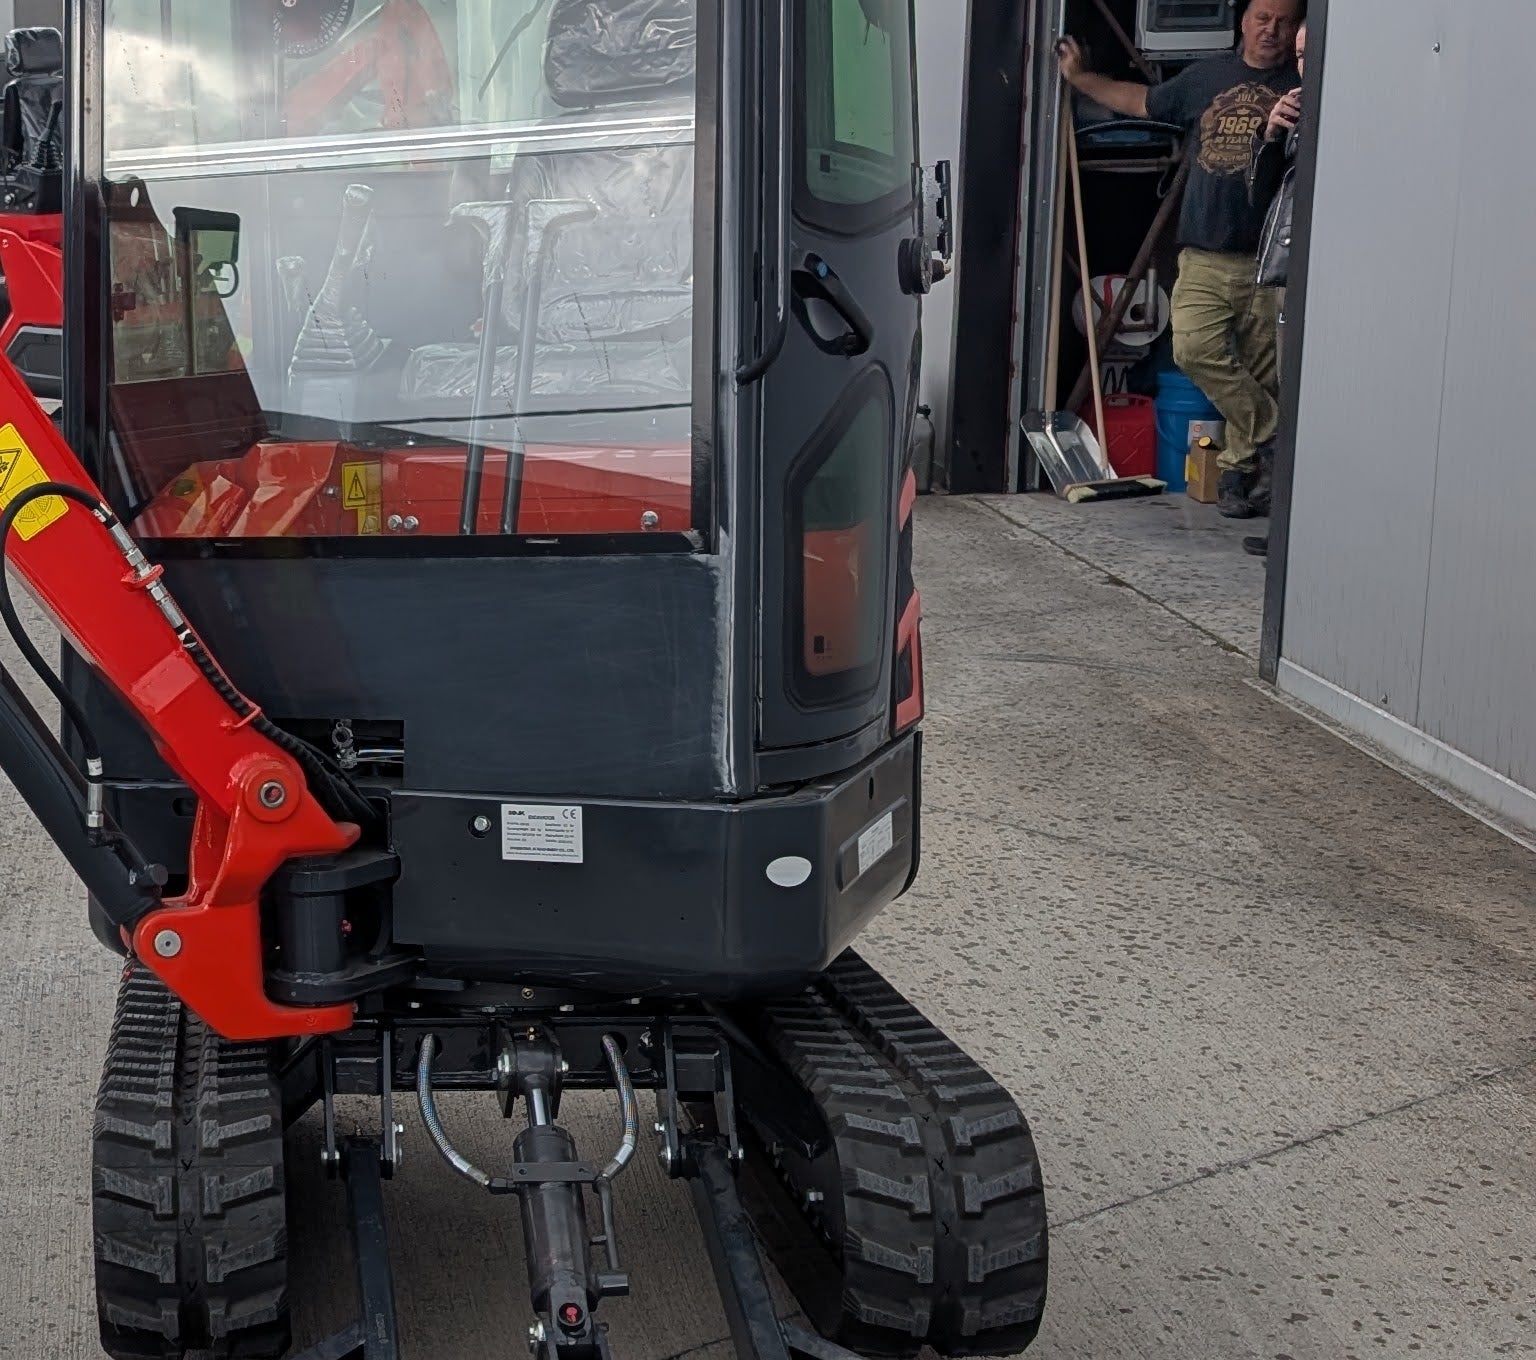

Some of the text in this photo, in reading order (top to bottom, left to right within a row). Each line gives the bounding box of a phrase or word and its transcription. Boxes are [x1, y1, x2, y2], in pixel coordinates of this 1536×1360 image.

[1235, 92, 1259, 102] JULY
[1218, 116, 1262, 135] 1969
[1225, 136, 1251, 144] YEAR
